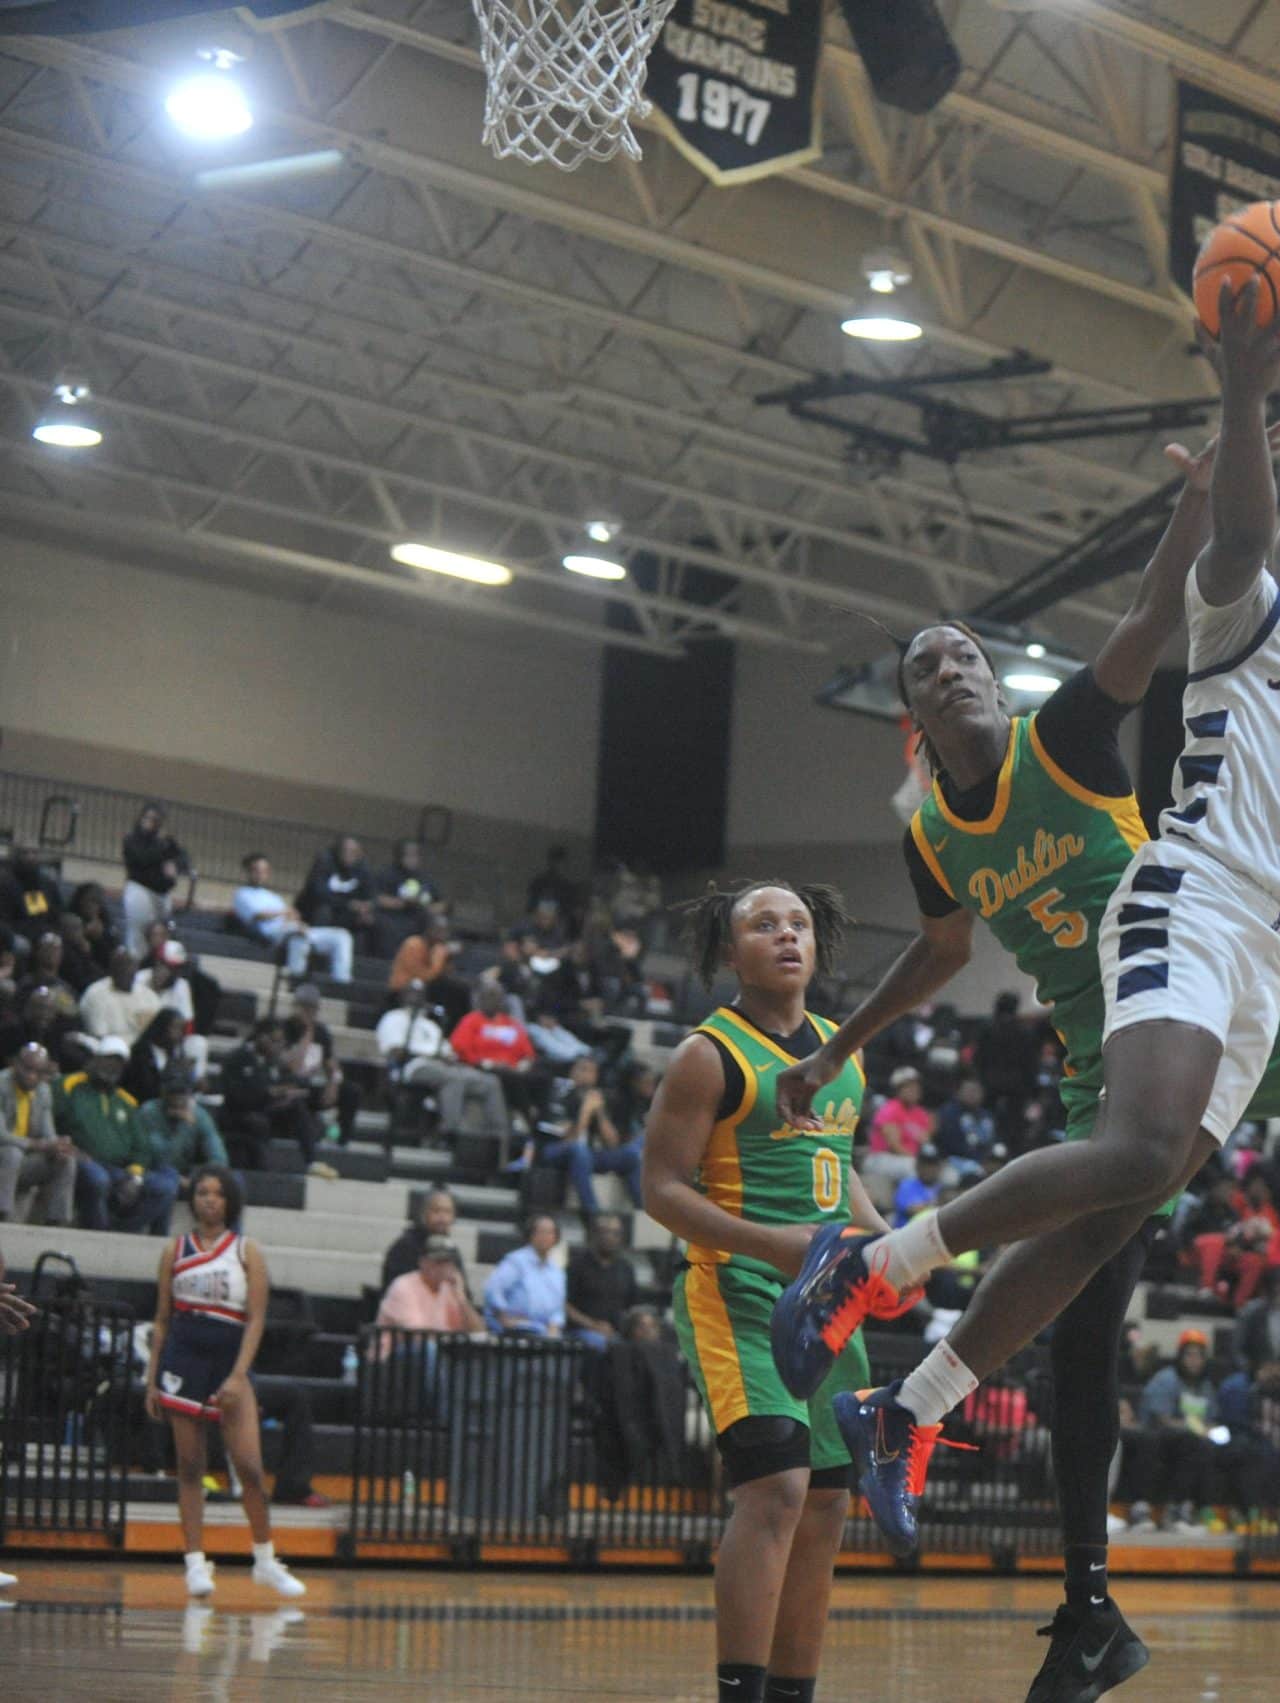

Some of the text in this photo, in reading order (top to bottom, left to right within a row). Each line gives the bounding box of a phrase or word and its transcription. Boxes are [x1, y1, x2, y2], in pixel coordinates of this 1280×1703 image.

[677, 72, 771, 145] 1977
[968, 828, 1085, 919] Dublin
[1026, 887, 1088, 948] 5
[812, 1147, 841, 1212] 0
